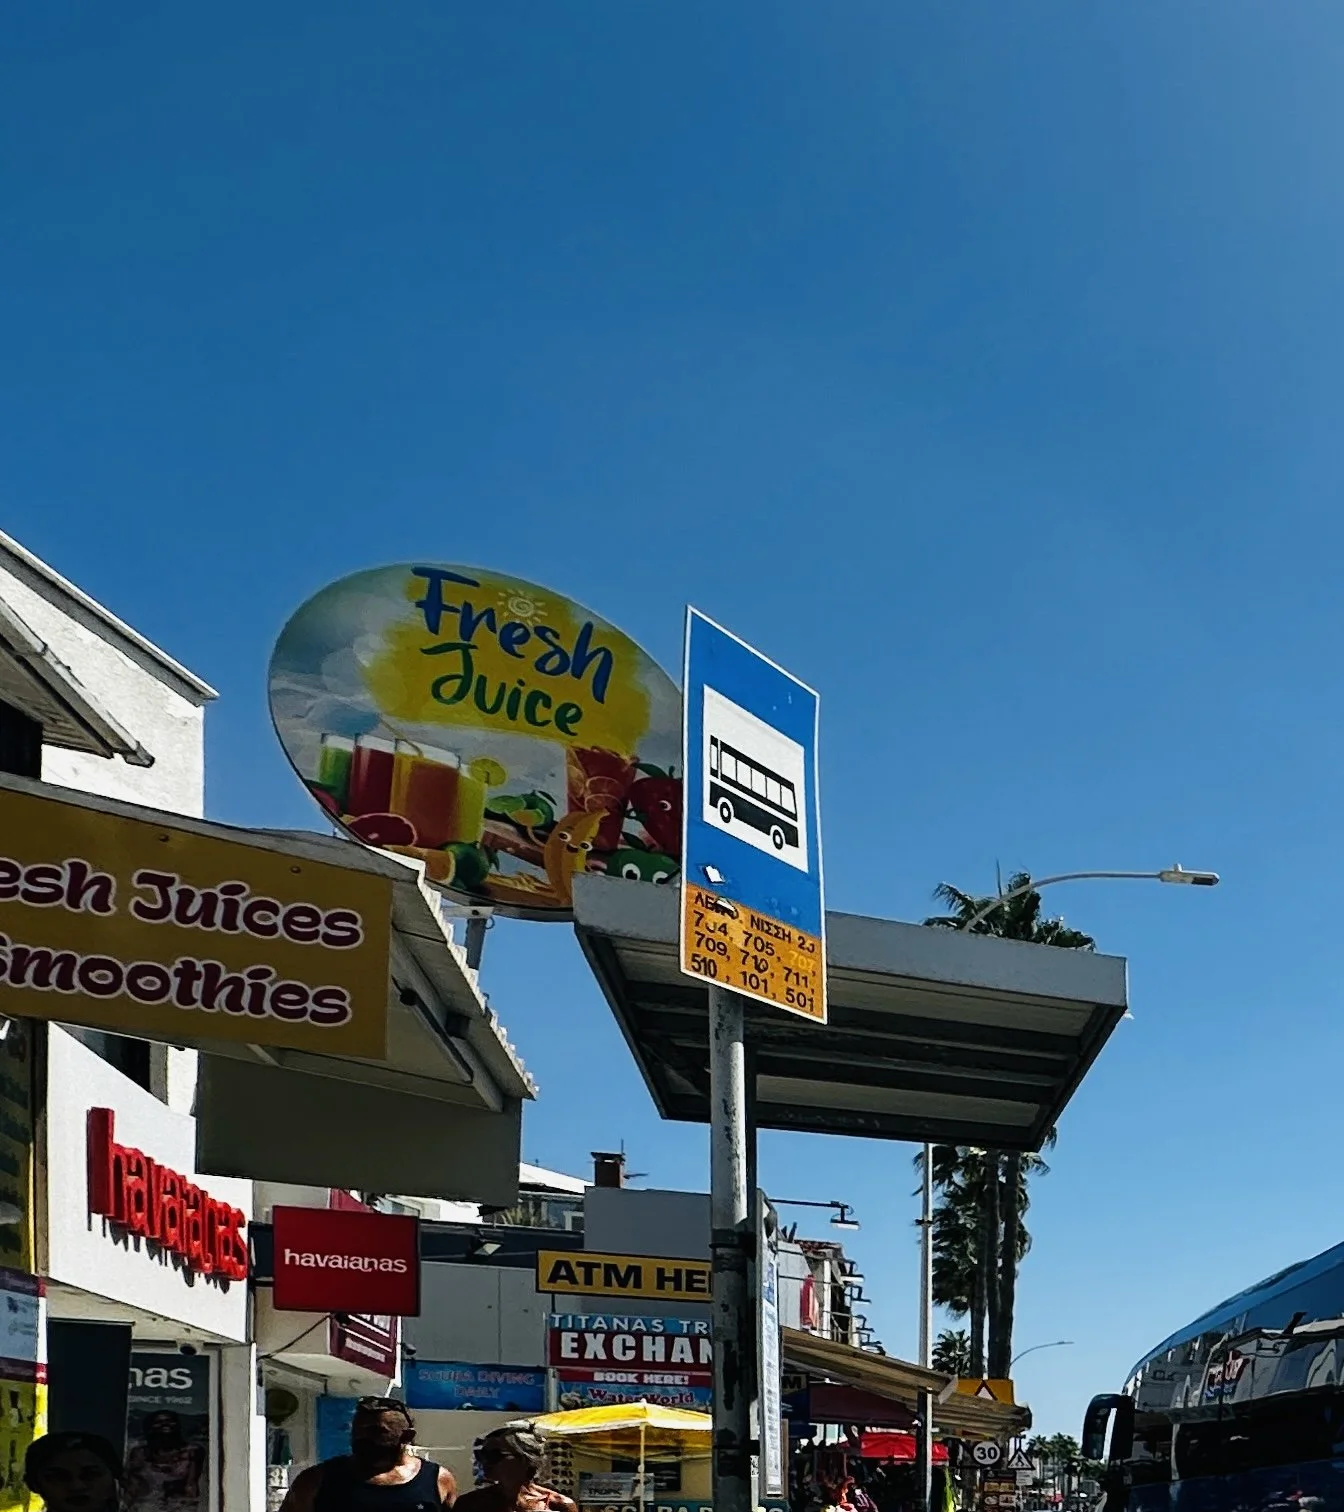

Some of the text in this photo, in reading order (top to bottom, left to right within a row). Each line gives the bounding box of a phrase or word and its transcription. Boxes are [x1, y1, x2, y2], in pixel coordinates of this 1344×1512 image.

[411, 565, 614, 704] Fresh
[421, 642, 583, 737] Juice
[131, 870, 363, 948] Juices
[0, 932, 353, 1028] moothies
[785, 988, 814, 1012] 501
[87, 1106, 247, 1281] havaianas
[284, 1248, 408, 1274] havaianas
[547, 1260, 712, 1293] ATM HE
[551, 1314, 665, 1333] TITANAS
[593, 1371, 639, 1384] BOOK
[976, 1447, 998, 1461] 30
